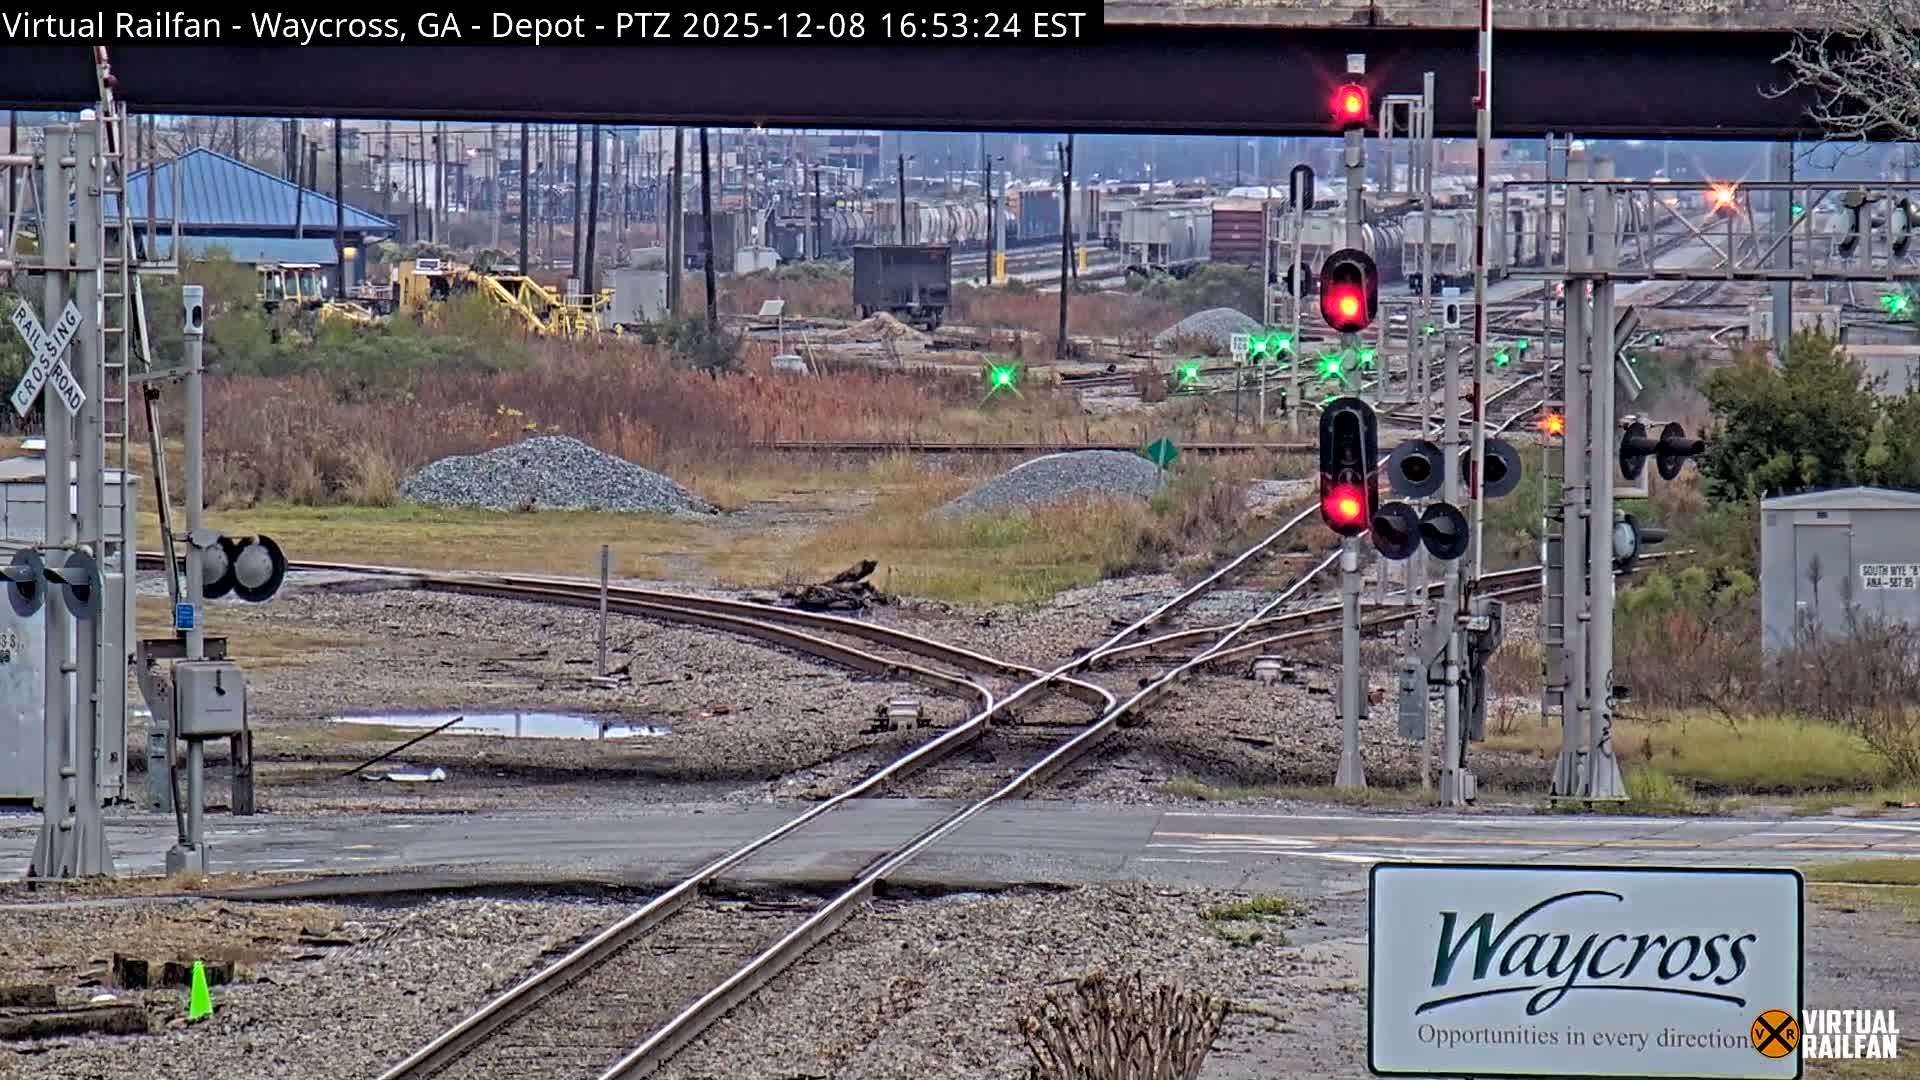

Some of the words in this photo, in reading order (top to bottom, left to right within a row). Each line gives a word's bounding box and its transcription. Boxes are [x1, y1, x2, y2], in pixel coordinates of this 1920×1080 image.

[15, 306, 41, 352] RAIL
[52, 364, 81, 410] ROAD
[16, 310, 77, 406] CROSSING
[1863, 565, 1889, 576] SOUTH
[1890, 565, 1907, 576] WYE
[1431, 890, 1757, 1016] Waycross
[1418, 1023, 1559, 1048] Opportunities
[1567, 1026, 1586, 1046] in
[1592, 1032, 1649, 1051] every
